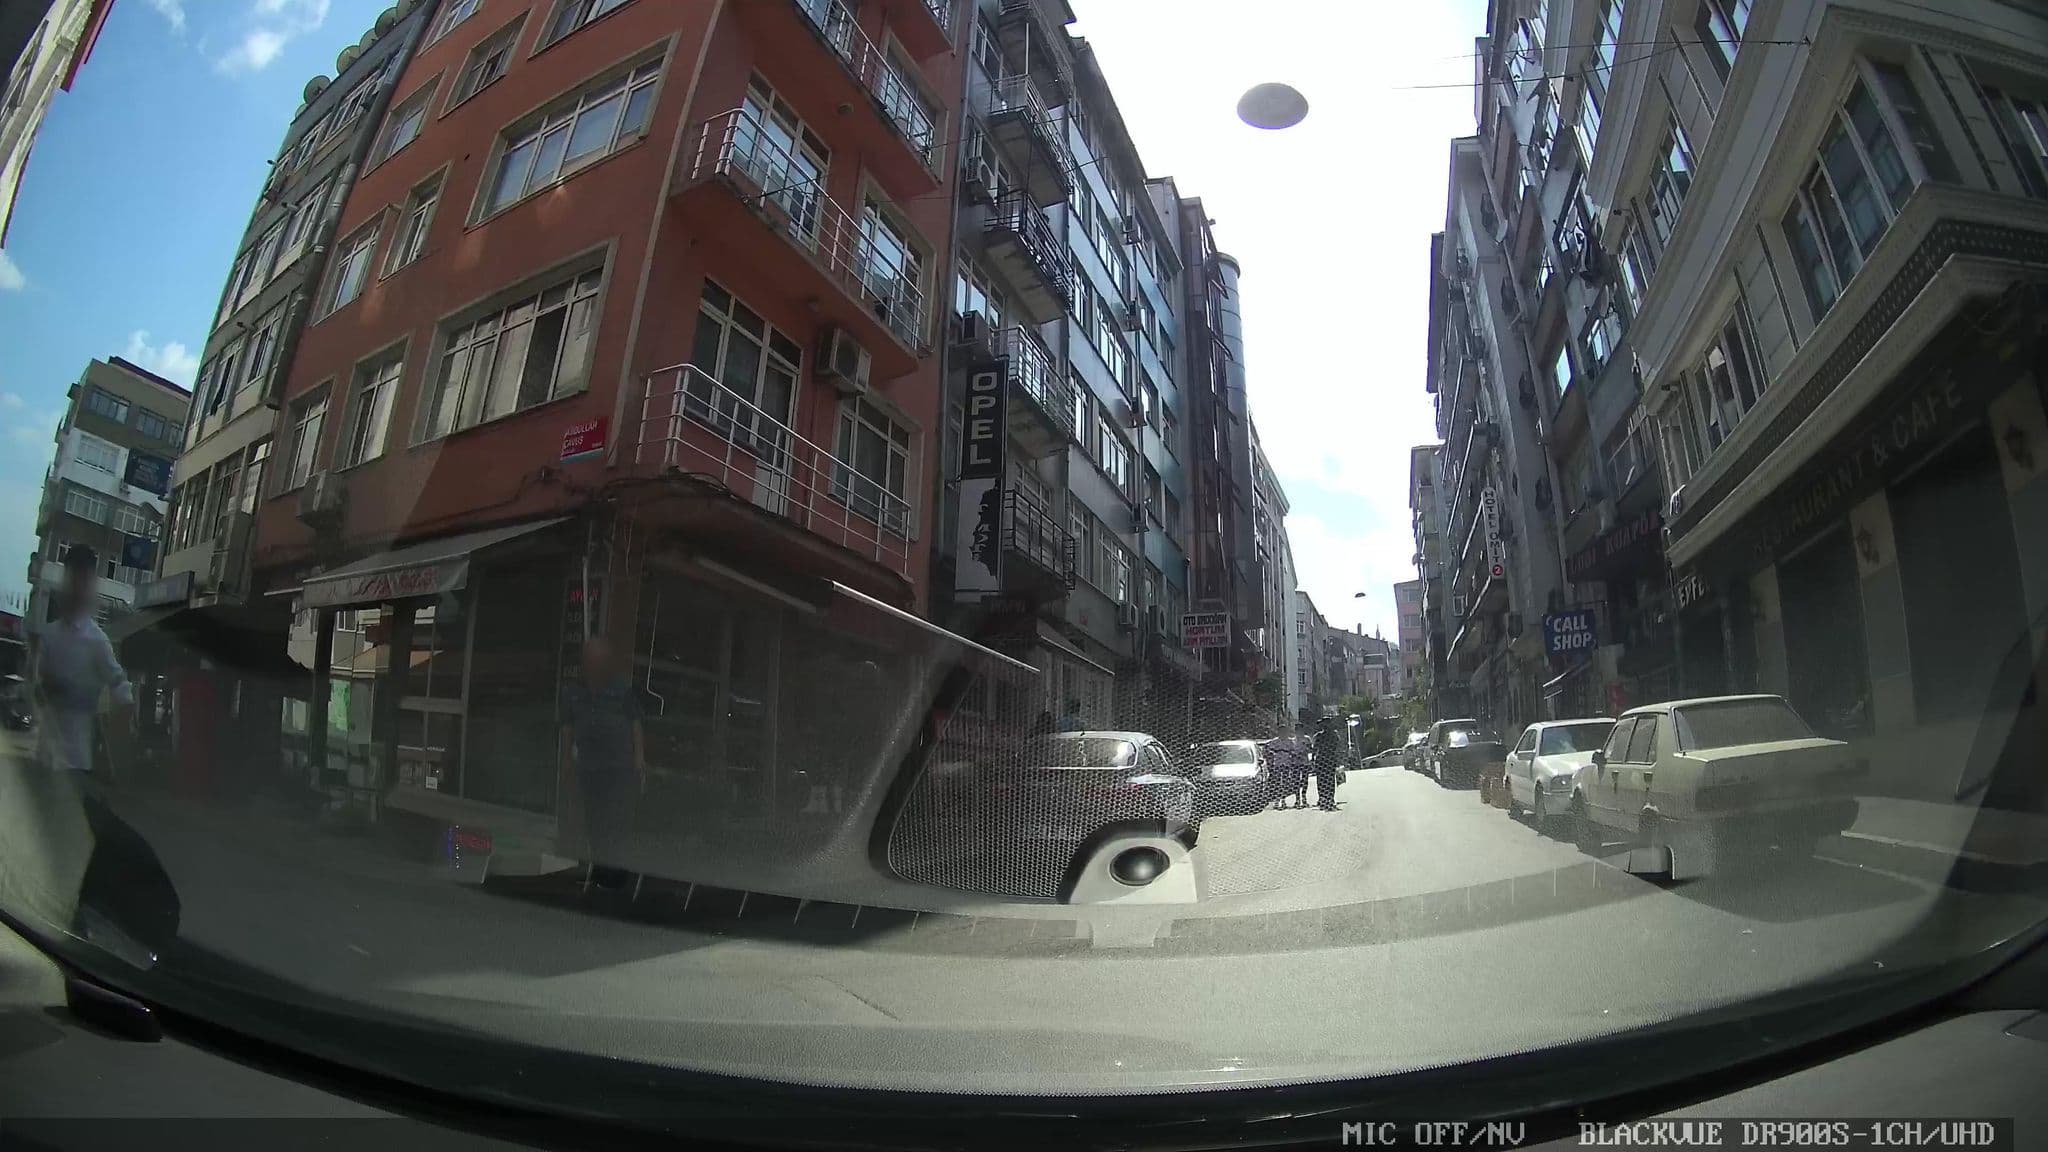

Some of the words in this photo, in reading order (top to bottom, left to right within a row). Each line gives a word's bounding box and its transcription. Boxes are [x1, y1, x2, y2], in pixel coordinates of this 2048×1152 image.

[968, 371, 998, 465] OPEL
[1484, 491, 1497, 529] HOTEL
[1605, 512, 1659, 557] KUAFÖ
[1183, 615, 1196, 627] OTO
[1553, 615, 1588, 633] CALL
[1553, 632, 1592, 651] SHOP
